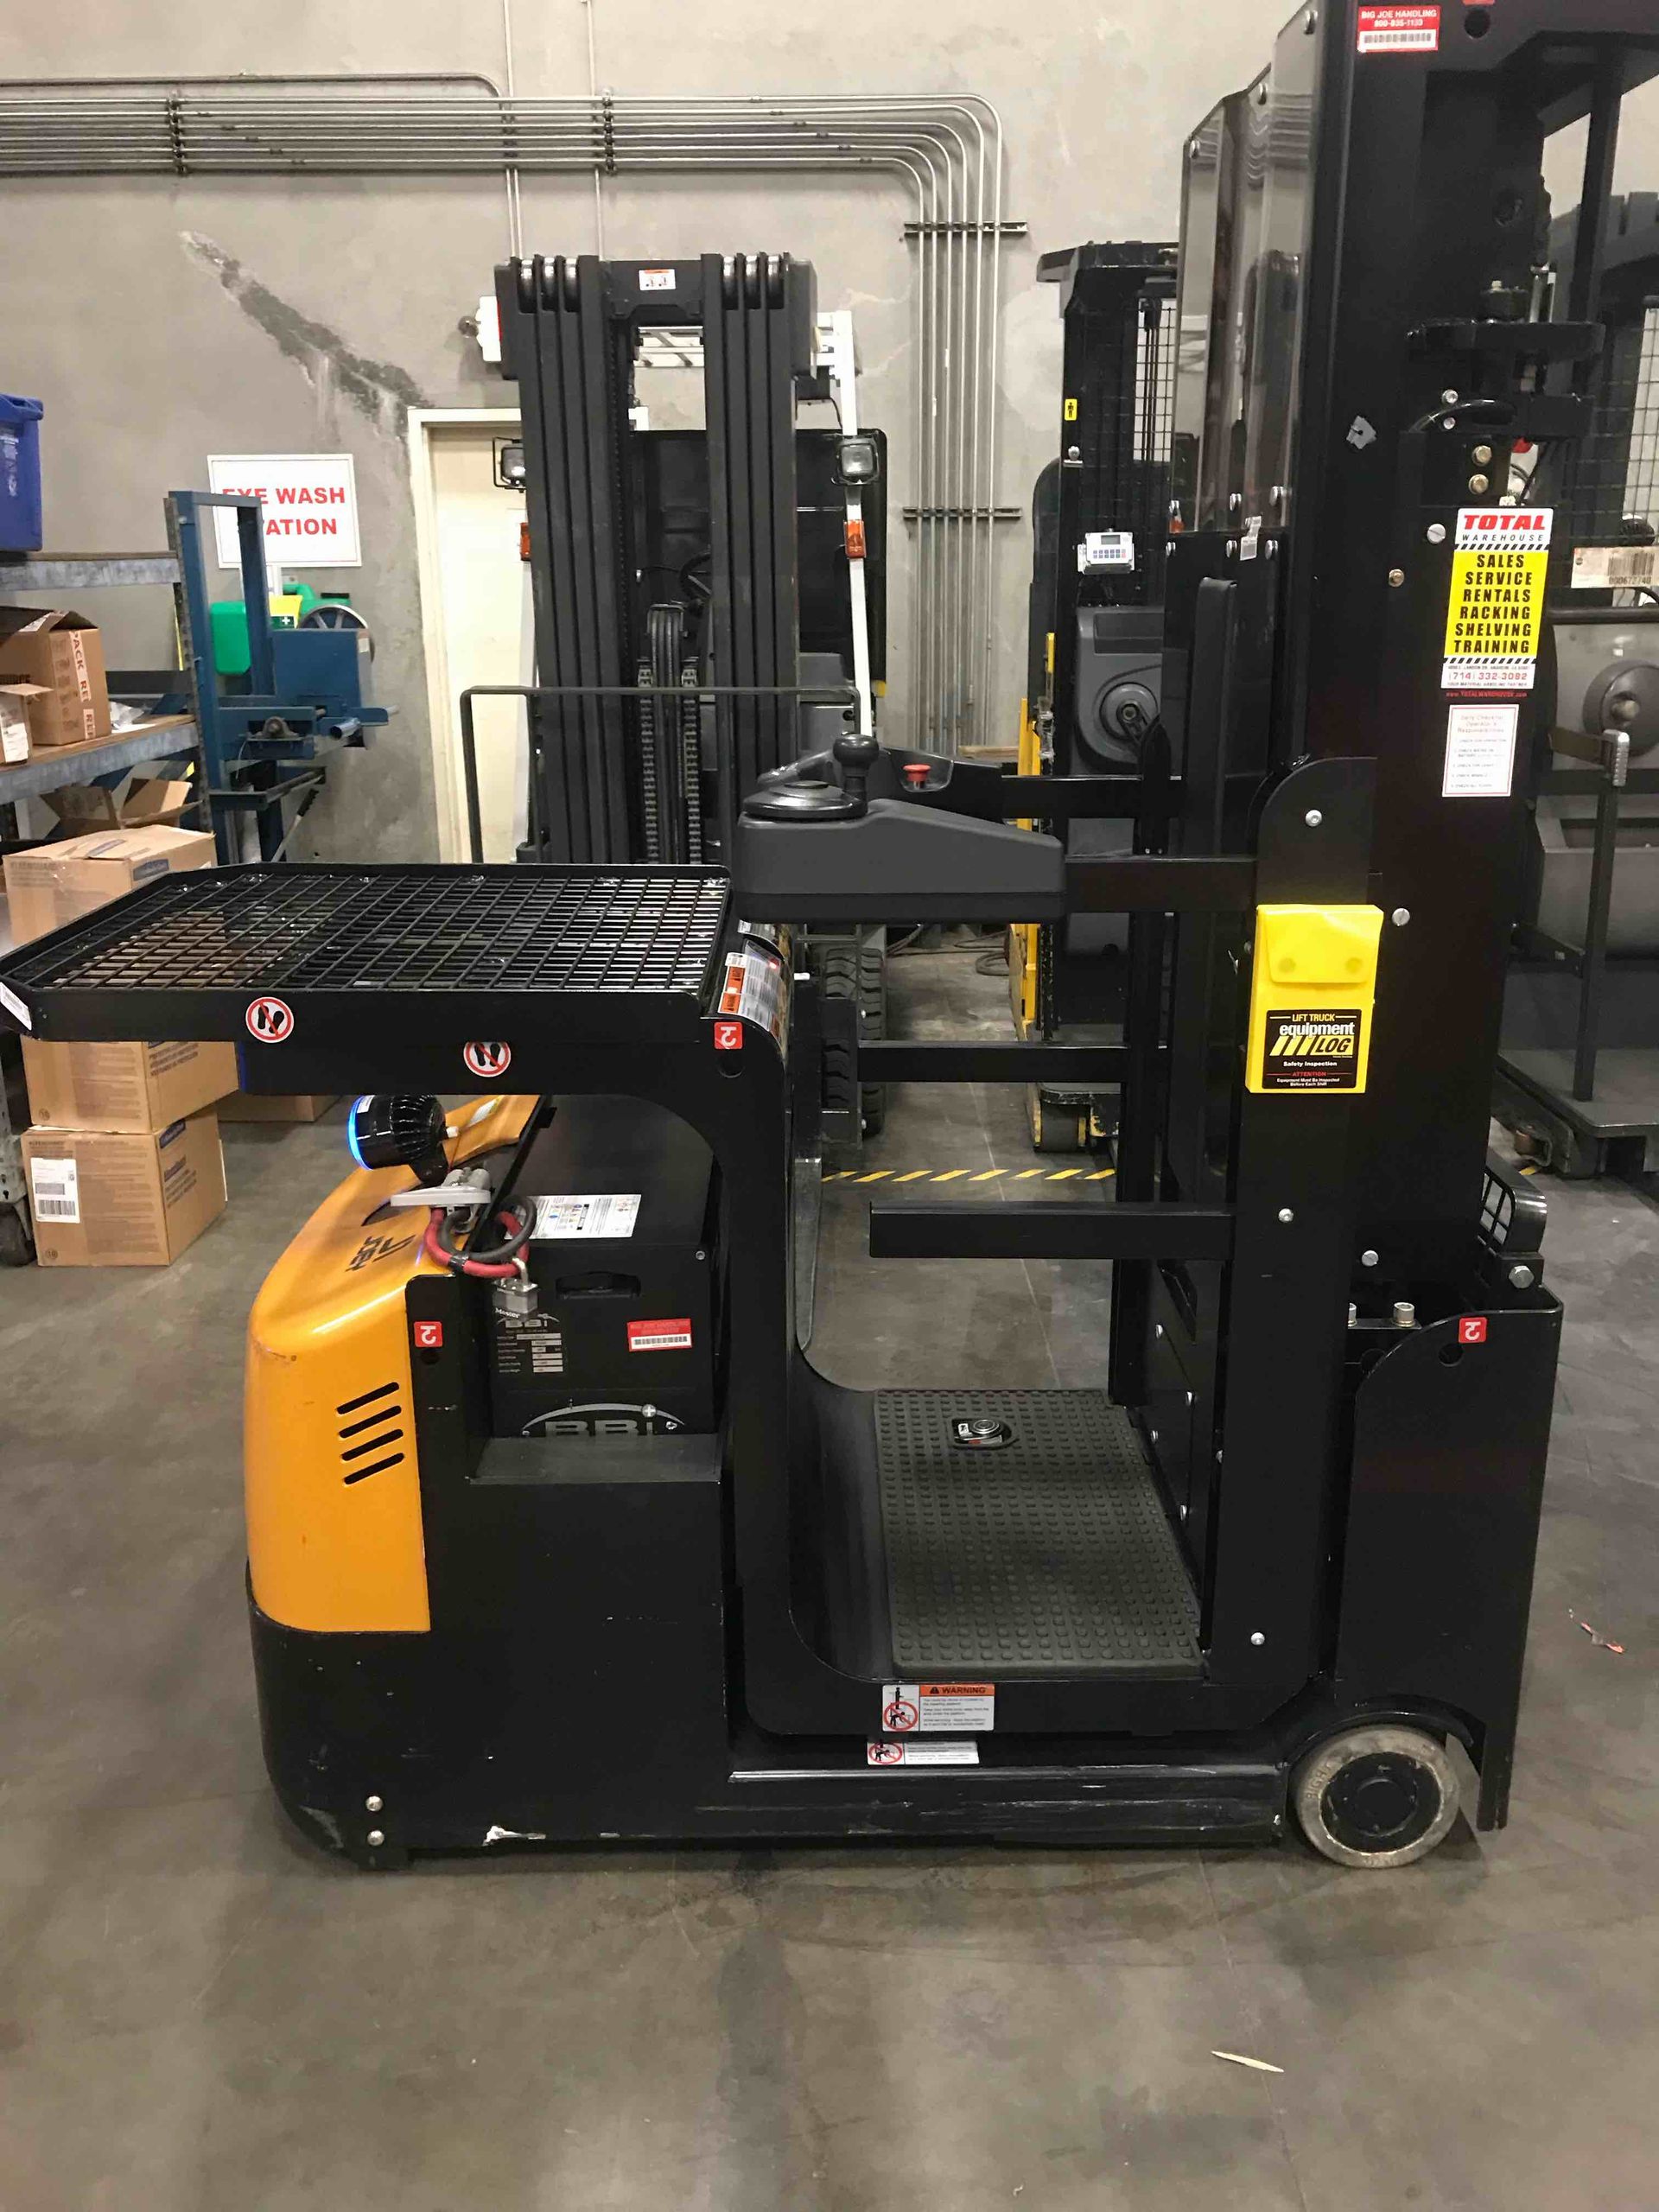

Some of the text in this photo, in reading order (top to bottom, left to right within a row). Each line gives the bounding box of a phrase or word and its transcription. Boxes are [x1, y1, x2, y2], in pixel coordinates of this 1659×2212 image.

[1395, 10, 1437, 18] HANDLING
[276, 487, 346, 505] WASH
[263, 518, 338, 536] ATION
[1464, 515, 1545, 531] TOTAL
[1477, 554, 1524, 568] SALES
[1465, 571, 1533, 586] SERVICE
[1463, 588, 1531, 603] RENTALS
[1459, 606, 1531, 620] RACKING
[1455, 622, 1532, 637] SHELVING
[1454, 639, 1529, 653] TRAINING
[1292, 1013, 1336, 1022] LIFT TRUCK
[1279, 1022, 1355, 1039] equipment
[1315, 1038, 1351, 1053] LOG
[942, 1686, 987, 1694] WARNING
